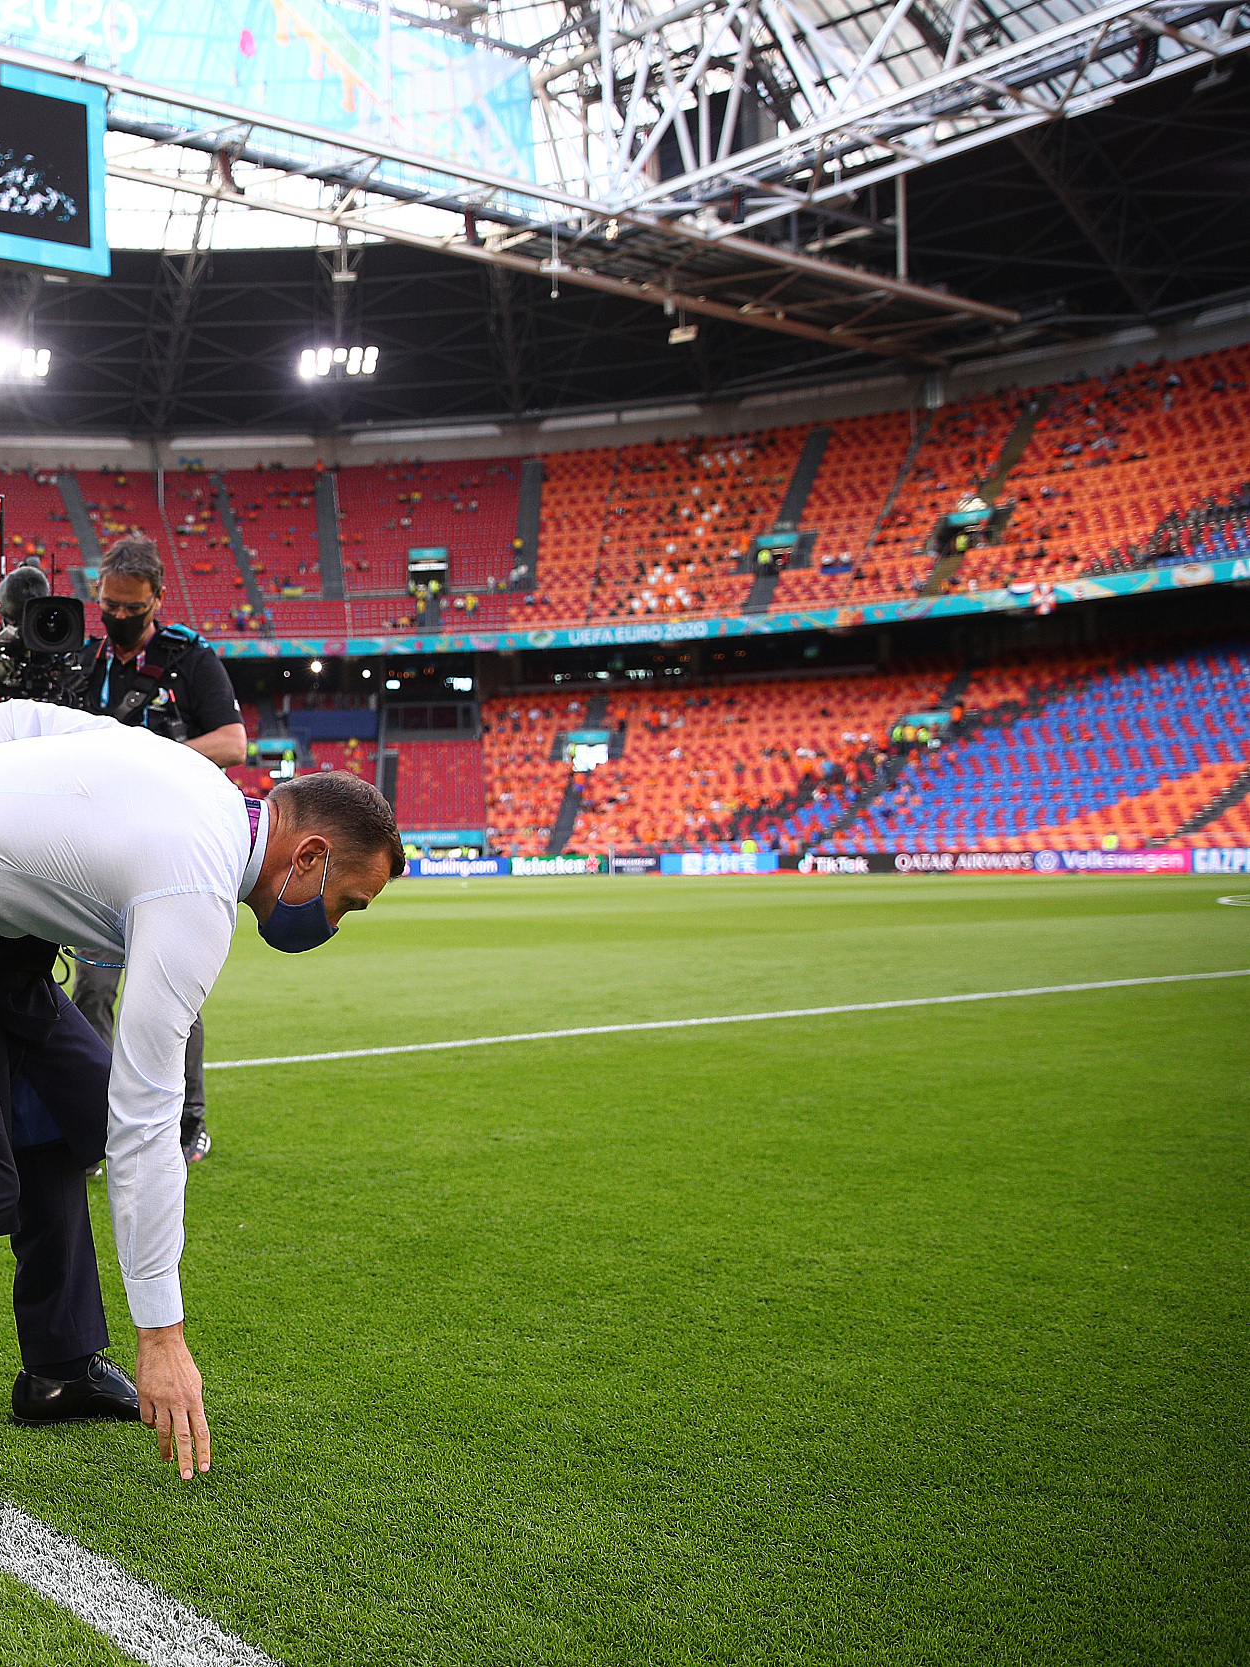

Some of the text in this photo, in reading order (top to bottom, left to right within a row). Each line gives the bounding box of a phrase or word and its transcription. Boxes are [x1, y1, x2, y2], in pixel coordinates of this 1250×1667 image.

[0, 0, 138, 53] 2020
[568, 621, 708, 646] UEFA EURO 2020
[511, 855, 586, 876] Heineken
[814, 856, 870, 874] TikTok
[895, 852, 954, 871] QATAR
[955, 852, 1034, 870] AIRWAYS
[1061, 850, 1184, 873] Volkswagen
[1194, 847, 1250, 873] GAZP
